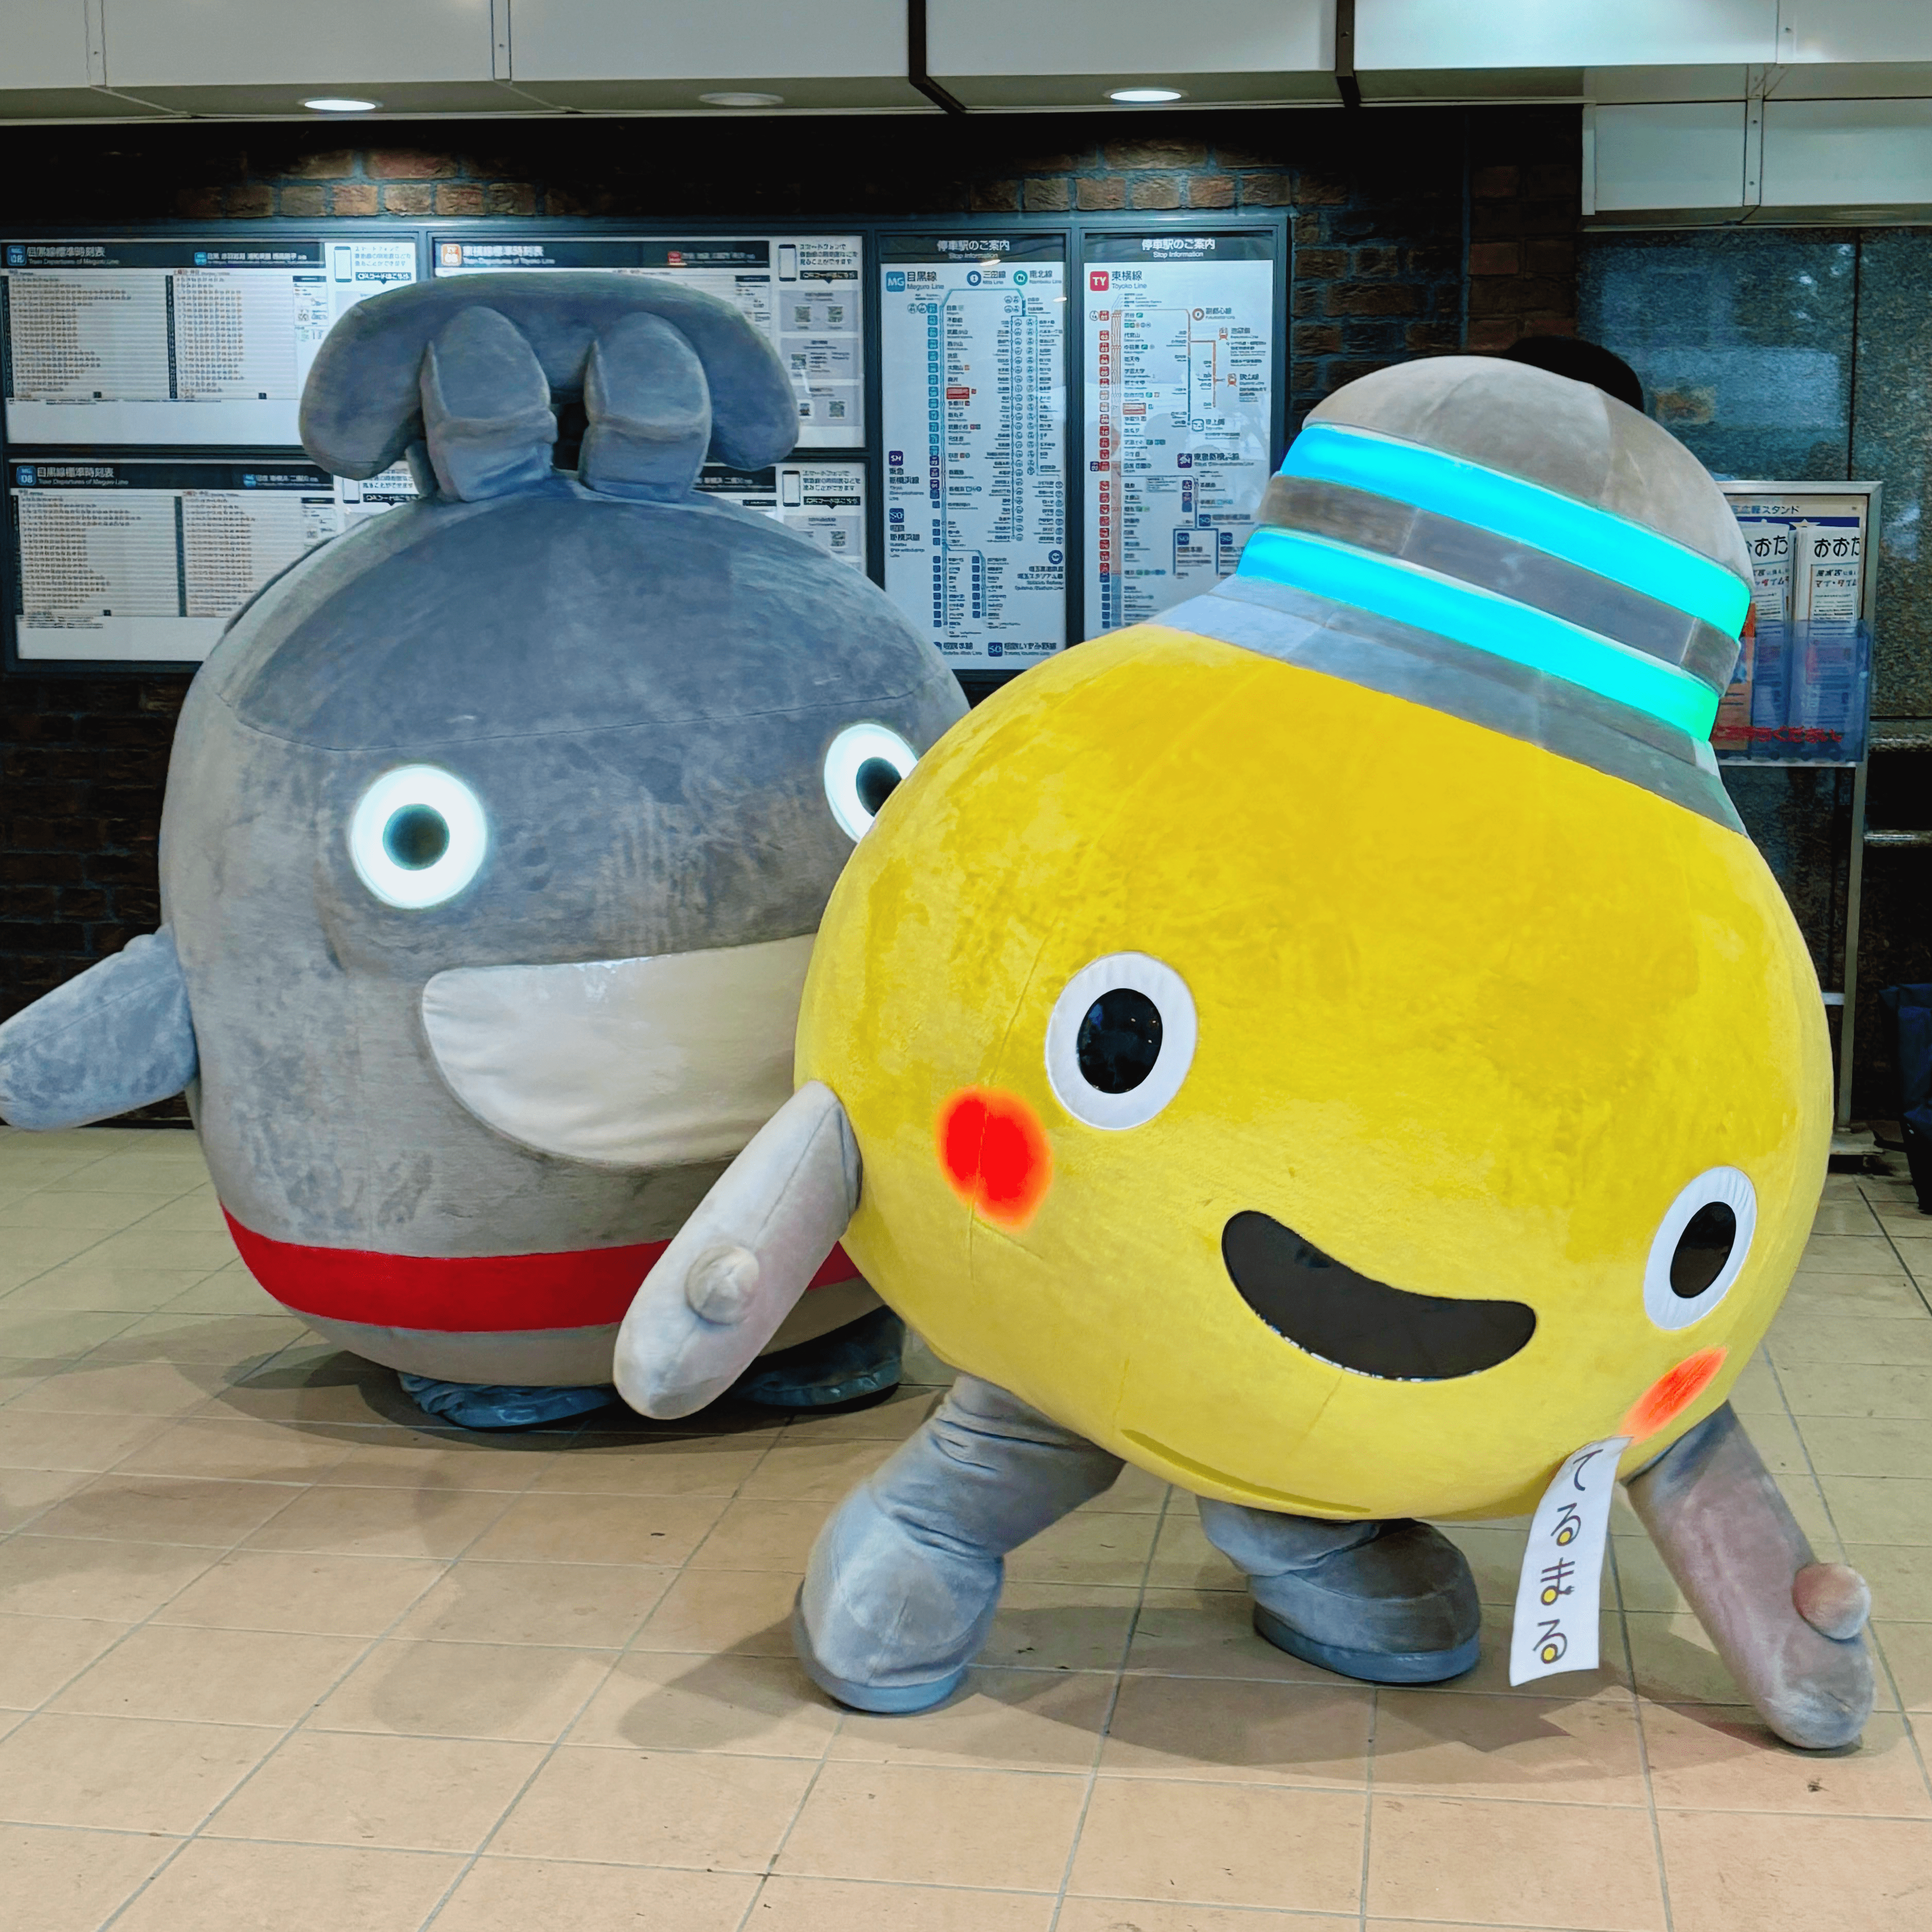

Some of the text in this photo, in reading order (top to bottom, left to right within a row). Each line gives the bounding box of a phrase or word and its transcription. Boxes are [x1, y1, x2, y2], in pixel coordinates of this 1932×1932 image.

[937, 240, 1010, 251] 停車駅のご案内
[1142, 238, 1215, 250] 停車駅のご案内
[907, 271, 937, 282] 目黒線
[1030, 270, 1053, 279] 南北線
[1112, 270, 1142, 281] 東横線
[887, 277, 904, 287] MG
[1092, 276, 1107, 286] TY
[1746, 535, 1789, 557] おた
[1533, 1448, 1603, 1664] てるまる
